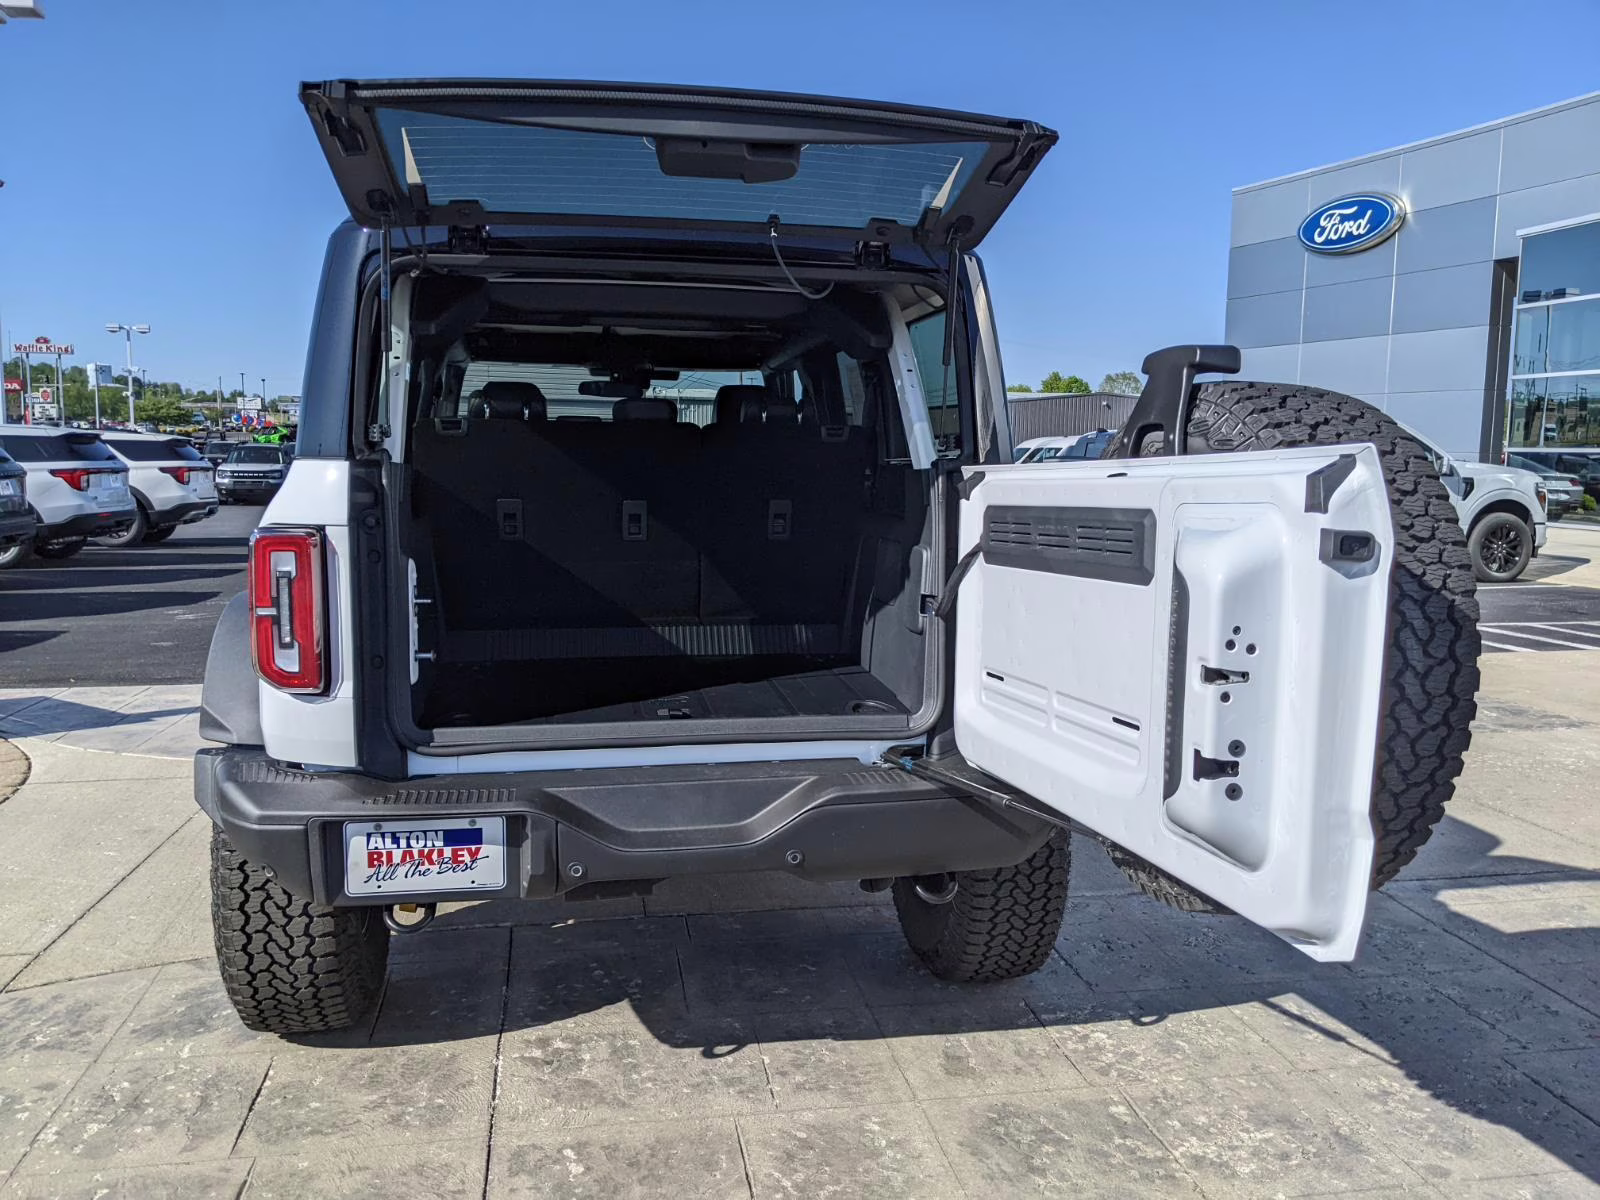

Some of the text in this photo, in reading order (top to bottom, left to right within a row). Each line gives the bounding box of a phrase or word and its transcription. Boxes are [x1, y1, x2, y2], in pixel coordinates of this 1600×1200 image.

[1314, 206, 1372, 244] Ford
[15, 344, 70, 353] Waffle King
[367, 830, 444, 850] ALTON
[367, 847, 482, 869] BLAKLEY
[364, 855, 490, 884] All The Best
